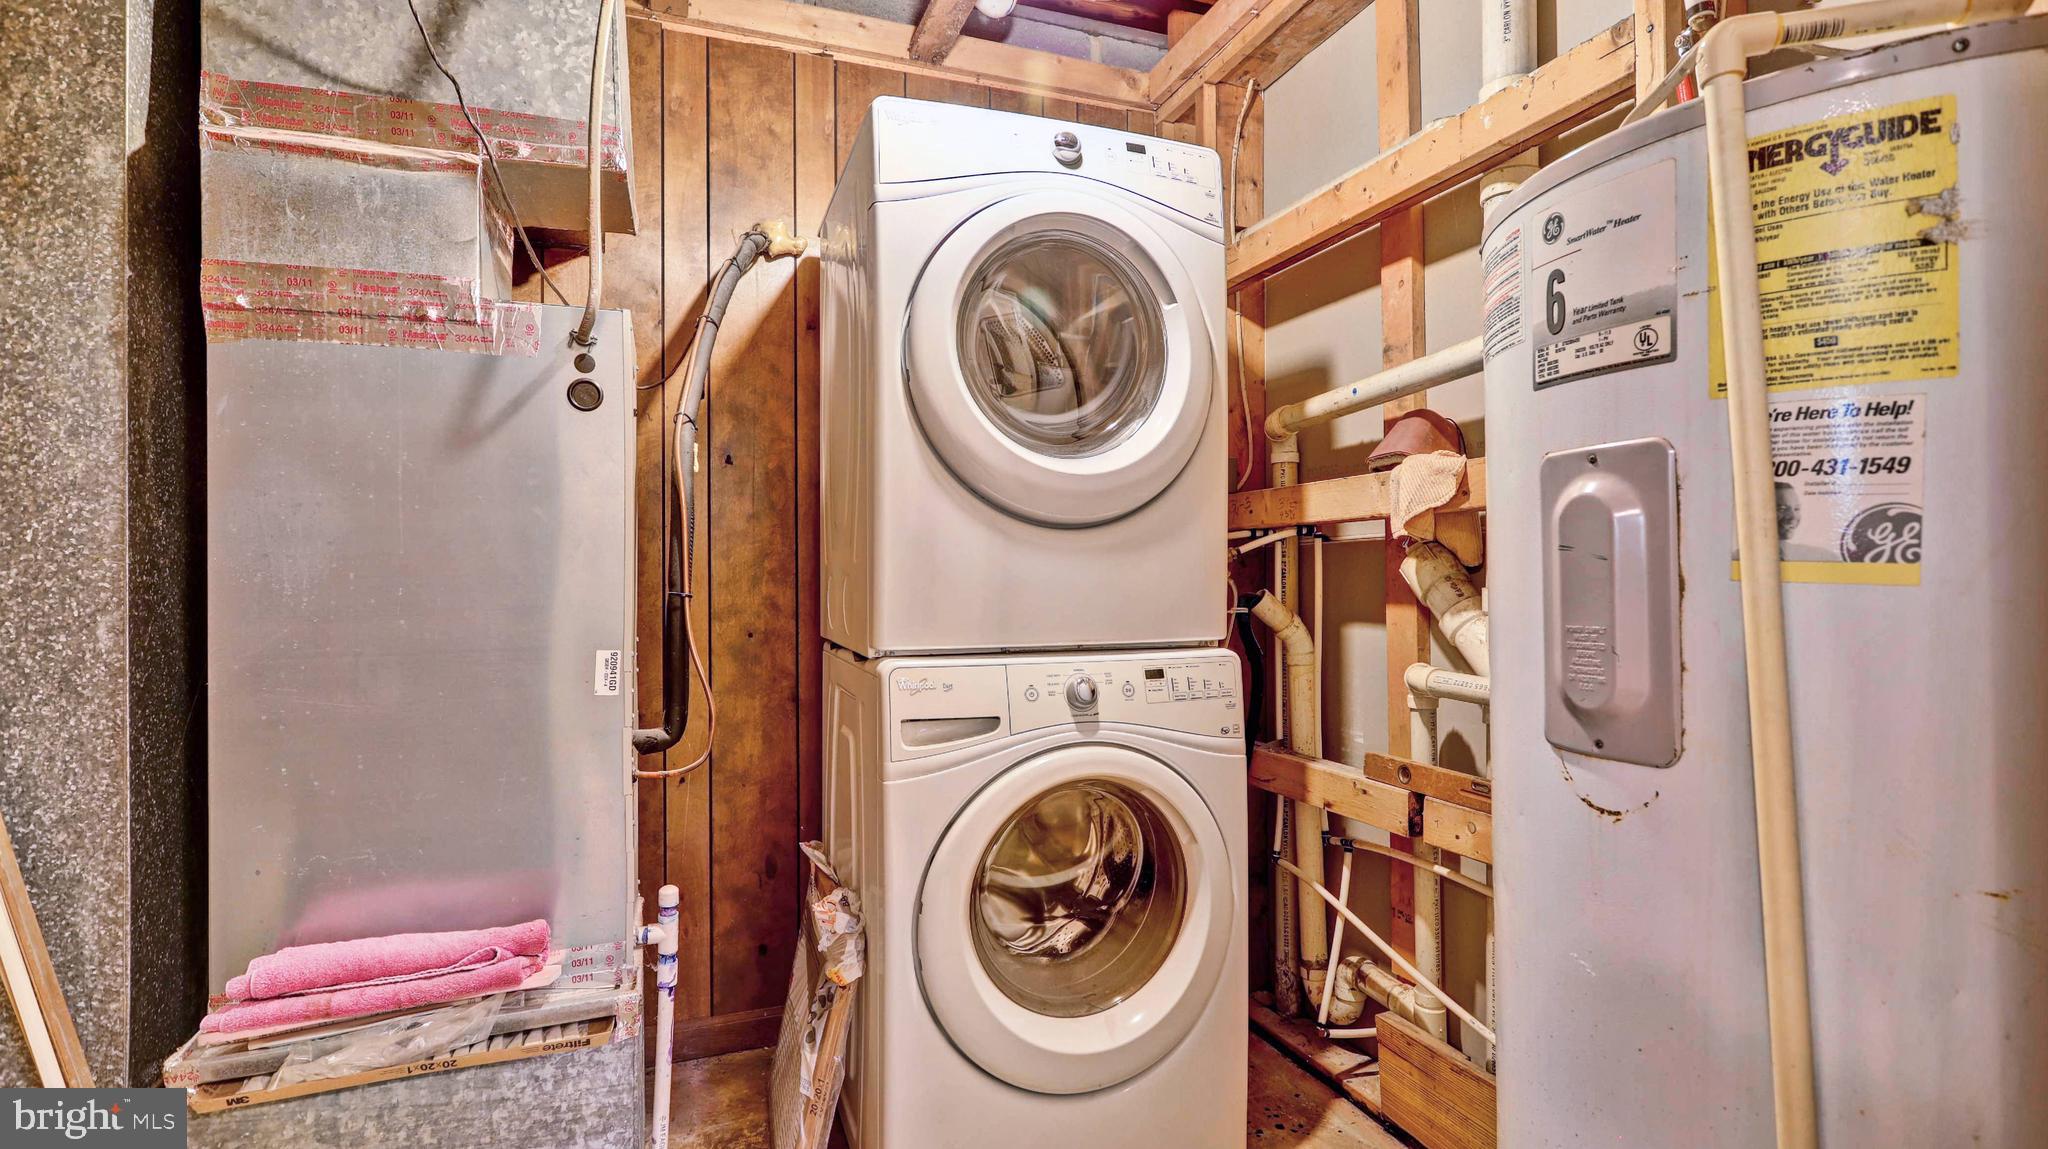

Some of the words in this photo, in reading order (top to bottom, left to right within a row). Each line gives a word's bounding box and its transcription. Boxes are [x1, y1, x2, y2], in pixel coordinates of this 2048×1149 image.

[390, 111, 415, 121] 03/11
[391, 127, 416, 137] 03/11
[1748, 108, 1942, 173] NERGYGUIDE
[1761, 200, 1775, 209] the
[1779, 192, 1810, 205] Energy
[1869, 175, 1899, 187] Water
[1903, 169, 1936, 182] Heater
[1758, 209, 1776, 220] with
[1780, 203, 1809, 215] Others
[1613, 213, 1641, 228] Heater
[202, 275, 229, 284] 324A
[286, 277, 312, 287] 03/11
[406, 288, 433, 297] 324A
[1546, 269, 1566, 335] 6
[1573, 306, 1587, 316] Year
[1588, 300, 1609, 312] Limited
[1610, 296, 1624, 306] Tank
[337, 308, 363, 317] 03/11
[1583, 313, 1597, 322] Parts
[1598, 305, 1627, 317] Warranty
[256, 323, 283, 333] 324A
[338, 325, 364, 334] 03/11
[455, 334, 480, 343] 324A
[1795, 406, 1838, 421] Here
[1843, 403, 1861, 418] To
[1865, 400, 1914, 419] Help!
[1772, 456, 1912, 477] 00-431-1549
[609, 652, 618, 691] 920941GD
[571, 957, 593, 967] 03/11
[571, 973, 594, 983] 03/11
[542, 1038, 591, 1051] Filtrete
[226, 1096, 250, 1107] 3M
